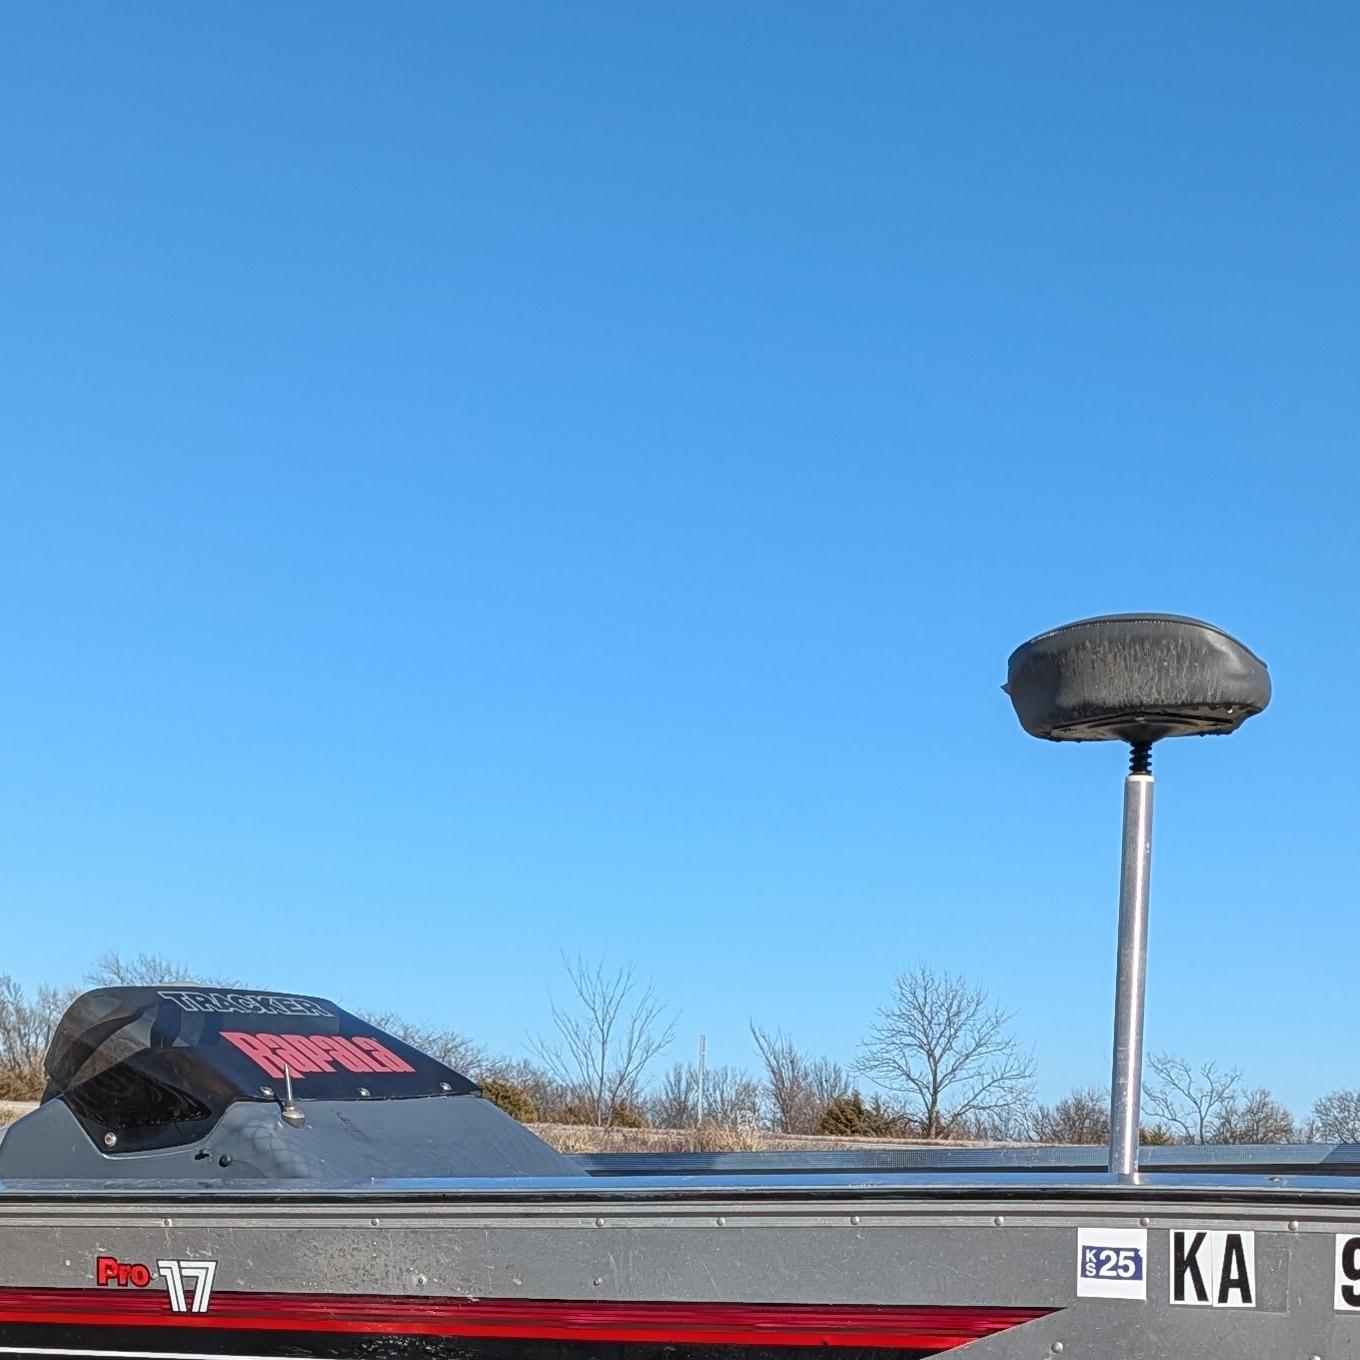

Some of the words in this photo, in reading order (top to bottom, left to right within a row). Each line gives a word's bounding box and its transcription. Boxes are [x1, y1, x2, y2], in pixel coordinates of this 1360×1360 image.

[156, 990, 336, 1018] TRACKER
[96, 1255, 152, 1288] Pro
[156, 1258, 218, 1313] 17
[1099, 1250, 1136, 1278] 25
[1173, 1231, 1253, 1304] KA
